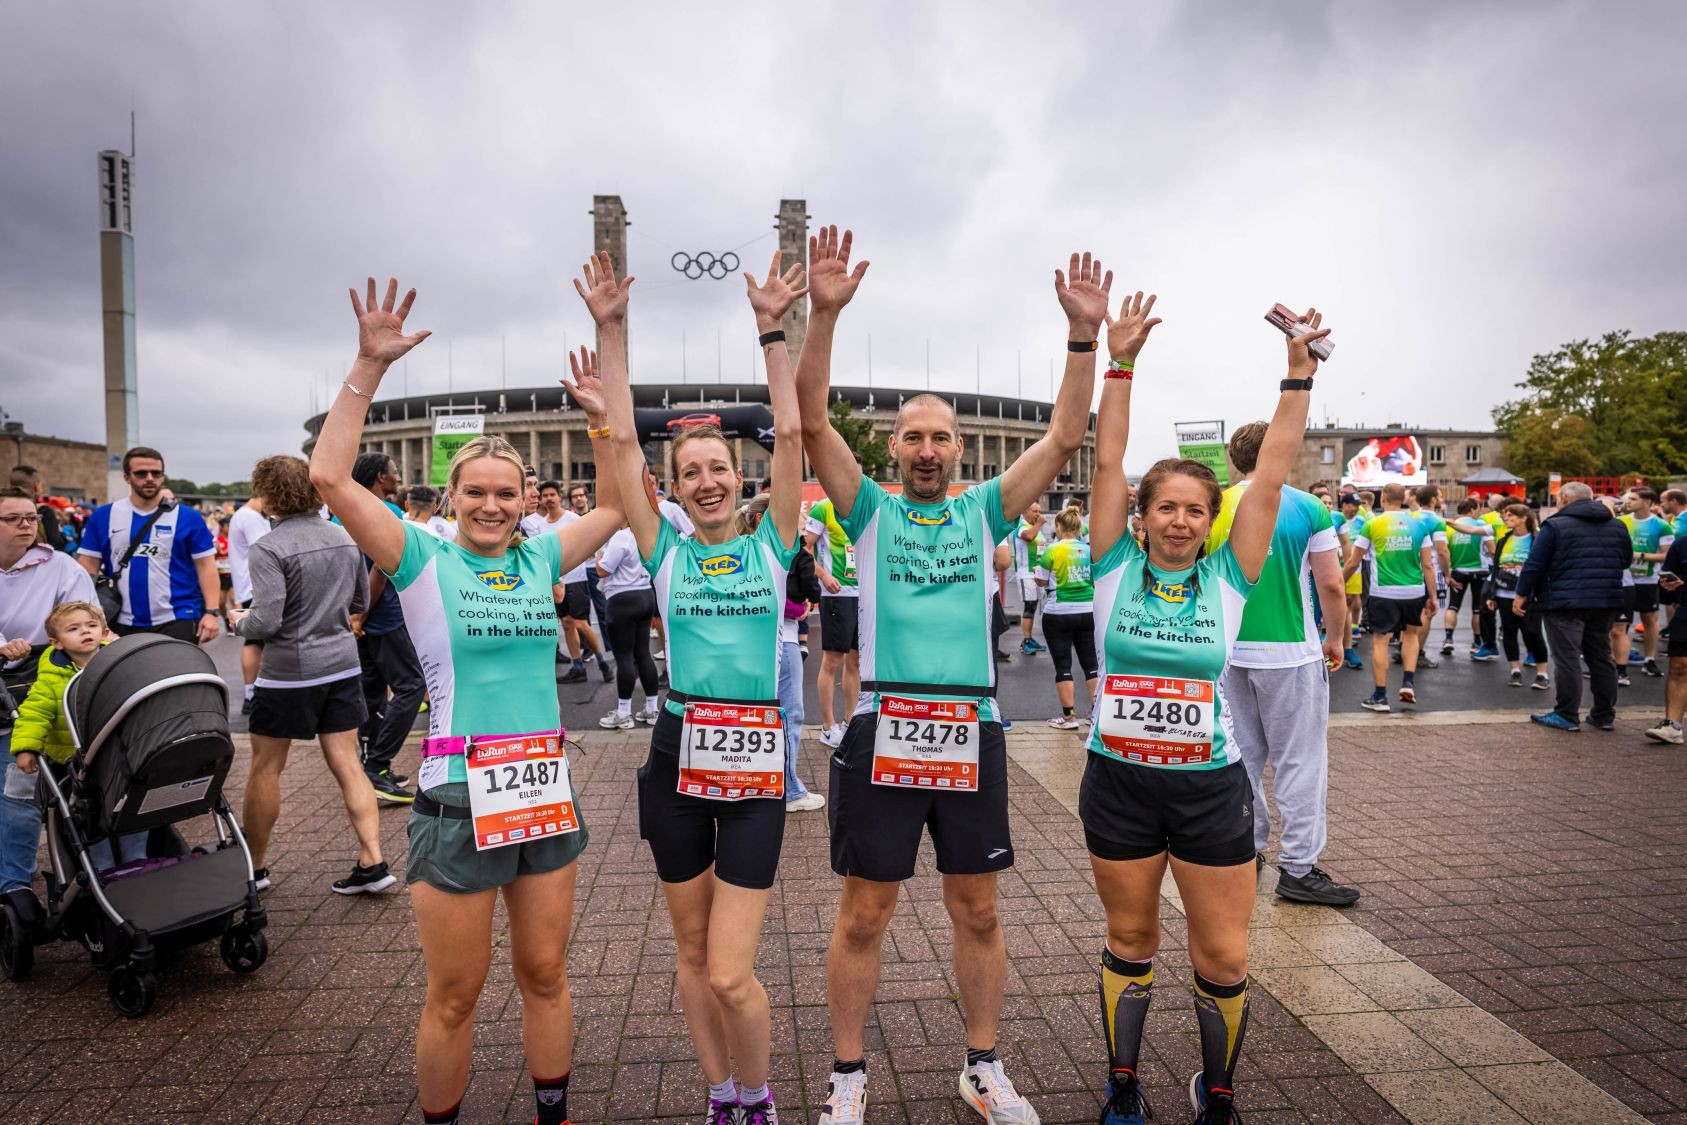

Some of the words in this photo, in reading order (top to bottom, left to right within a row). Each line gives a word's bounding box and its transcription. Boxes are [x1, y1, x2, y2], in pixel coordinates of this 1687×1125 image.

[440, 421, 478, 430] EINGANG
[1181, 432, 1217, 442] EINGANG
[139, 545, 159, 556] 24
[936, 558, 946, 569] it
[890, 570, 900, 582] in
[904, 571, 926, 584] the
[929, 571, 977, 584] kitchen.
[459, 589, 523, 605] Whatever
[739, 588, 772, 600] starts
[458, 608, 520, 623] cooking,
[523, 610, 532, 621] it
[676, 605, 686, 616] in
[690, 604, 713, 616] the
[717, 605, 771, 616] kitchen.
[467, 625, 482, 637] in
[487, 625, 512, 637] the
[1116, 621, 1126, 633] in
[1129, 626, 1152, 639] the
[1156, 631, 1215, 644] kitchen.
[1113, 698, 1202, 726] 12480
[889, 720, 969, 745] 12478
[695, 728, 776, 754] 12393
[1125, 741, 1156, 750] STARTZEIT
[1195, 745, 1203, 753] D
[912, 745, 943, 753] THOMAS
[721, 755, 752, 763] MADITA
[962, 765, 970, 774] D
[483, 760, 559, 794] 12487
[705, 774, 736, 782] STARTZEIT
[770, 775, 777, 784] D
[519, 789, 543, 799] EILEEN
[561, 804, 568, 815] D
